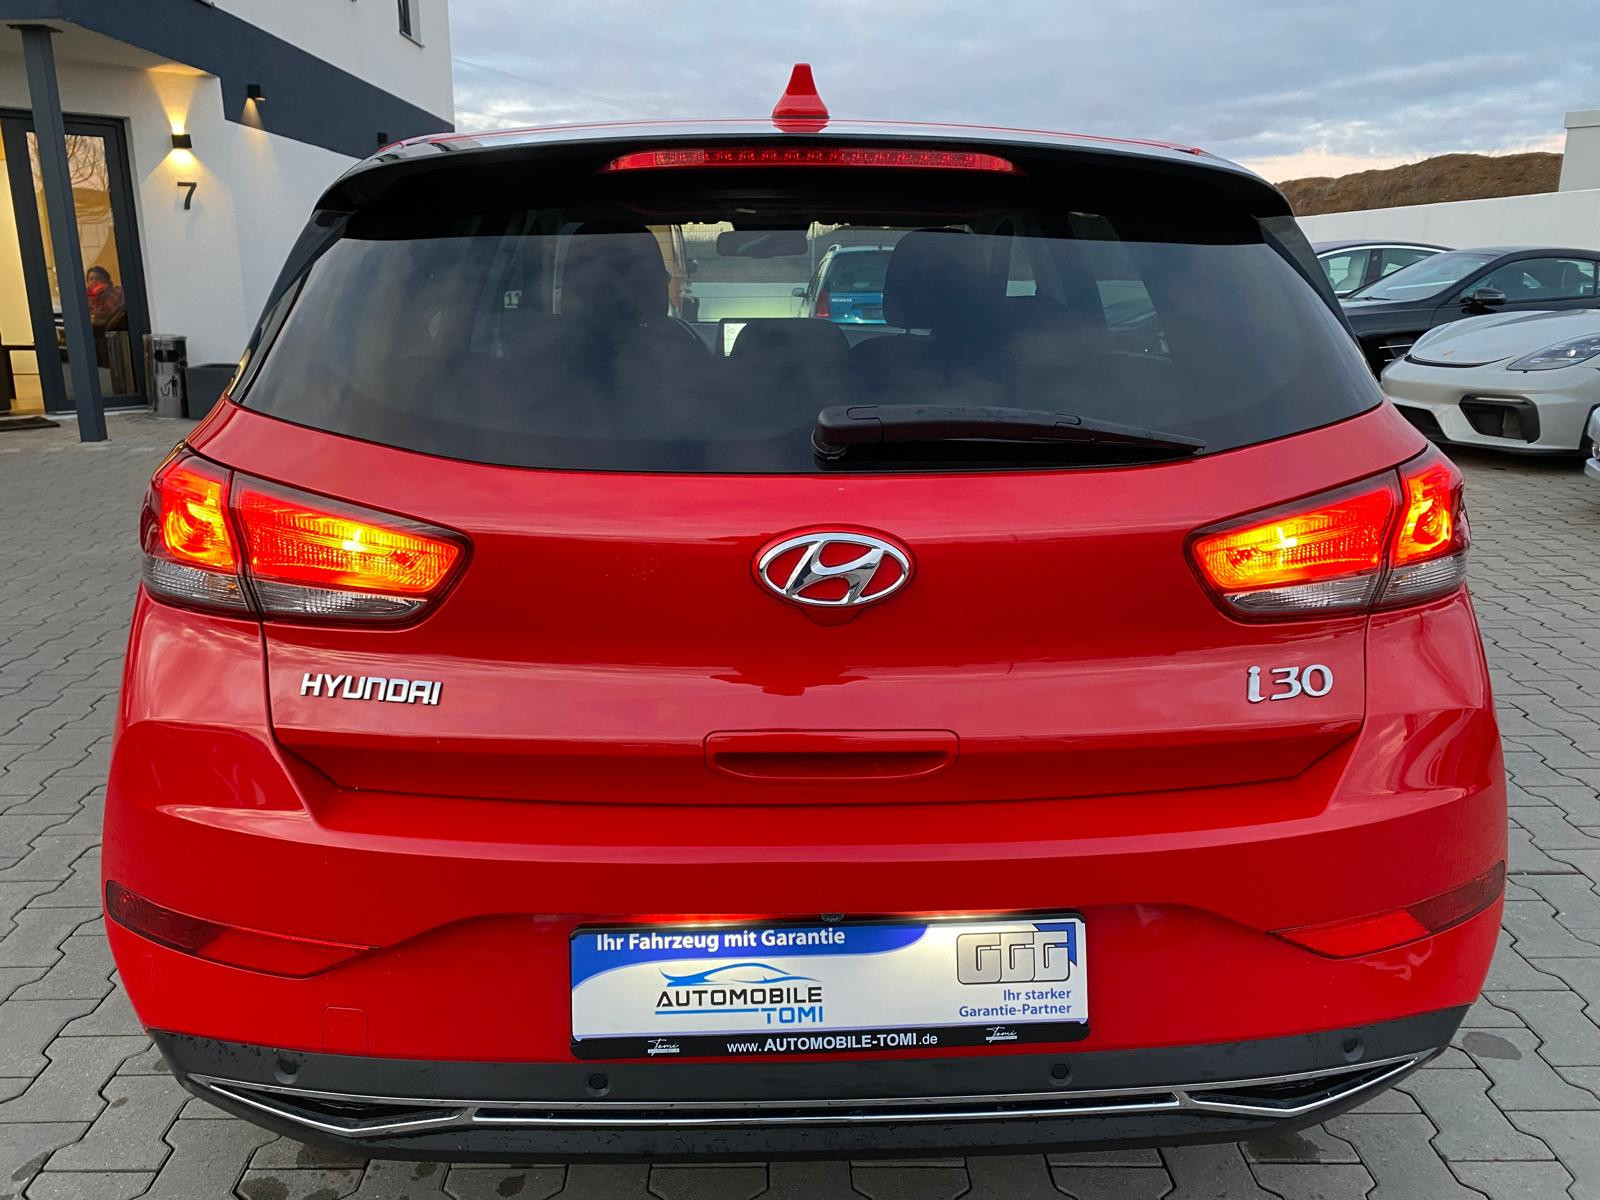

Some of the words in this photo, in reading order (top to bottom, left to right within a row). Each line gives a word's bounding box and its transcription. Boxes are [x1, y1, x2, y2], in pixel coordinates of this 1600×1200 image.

[177, 182, 197, 210] 7
[300, 672, 442, 705] HYUNDAI
[1247, 664, 1334, 703] i30
[597, 934, 624, 951] Ihr
[629, 932, 719, 952] Fahrzeug
[724, 929, 757, 948] mit
[761, 927, 846, 946] Garantie
[656, 986, 823, 1008] AUTOMOBILE
[1003, 989, 1021, 1001] Ihr
[1025, 987, 1072, 1000] starker
[761, 1006, 823, 1025] TOMI
[959, 1003, 1072, 1018] Garantie-Partner
[726, 1032, 938, 1053] www.AUTOMOBILE-TOMI.de
